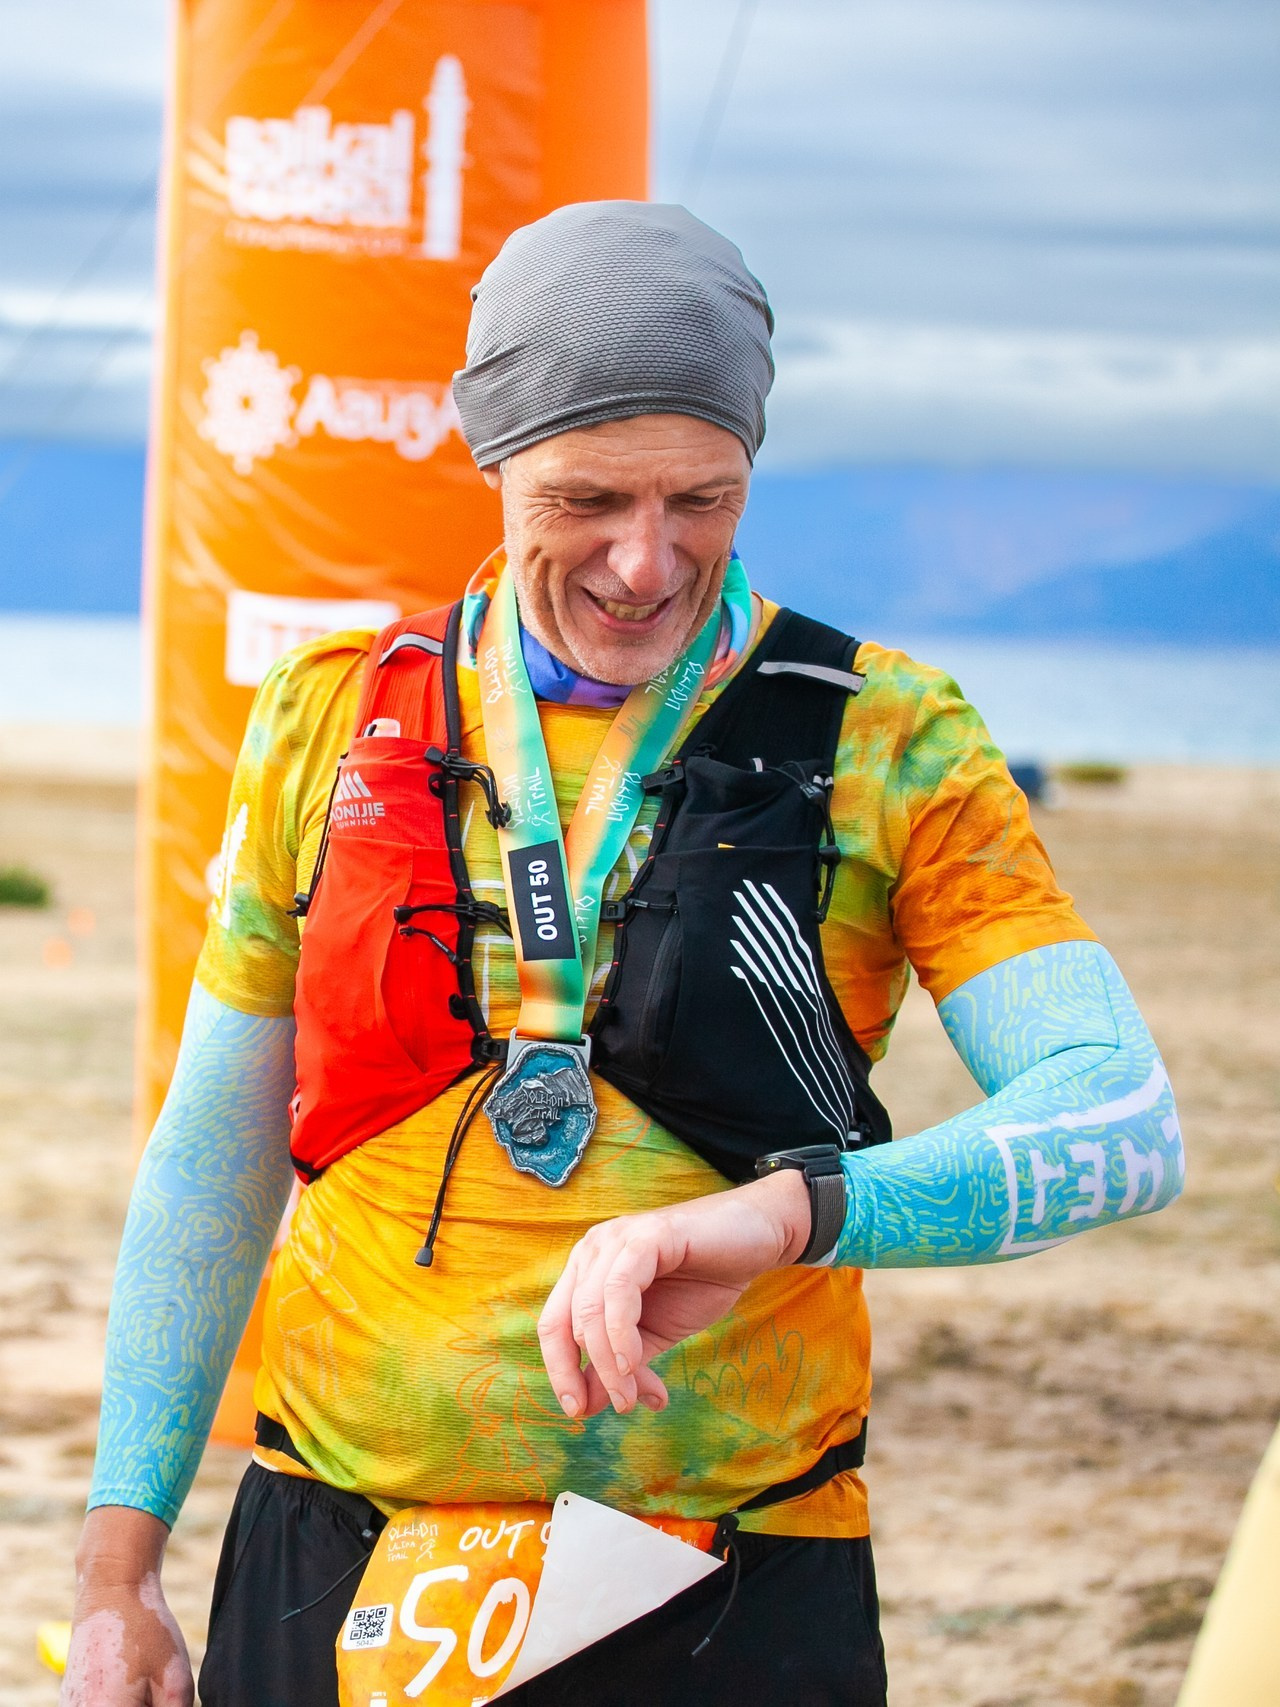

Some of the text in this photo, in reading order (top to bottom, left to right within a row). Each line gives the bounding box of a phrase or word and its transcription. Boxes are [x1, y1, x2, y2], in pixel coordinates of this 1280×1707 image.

[527, 859, 558, 941] OUT 50
[459, 1520, 535, 1559] OUT
[399, 1565, 531, 1697] 50
